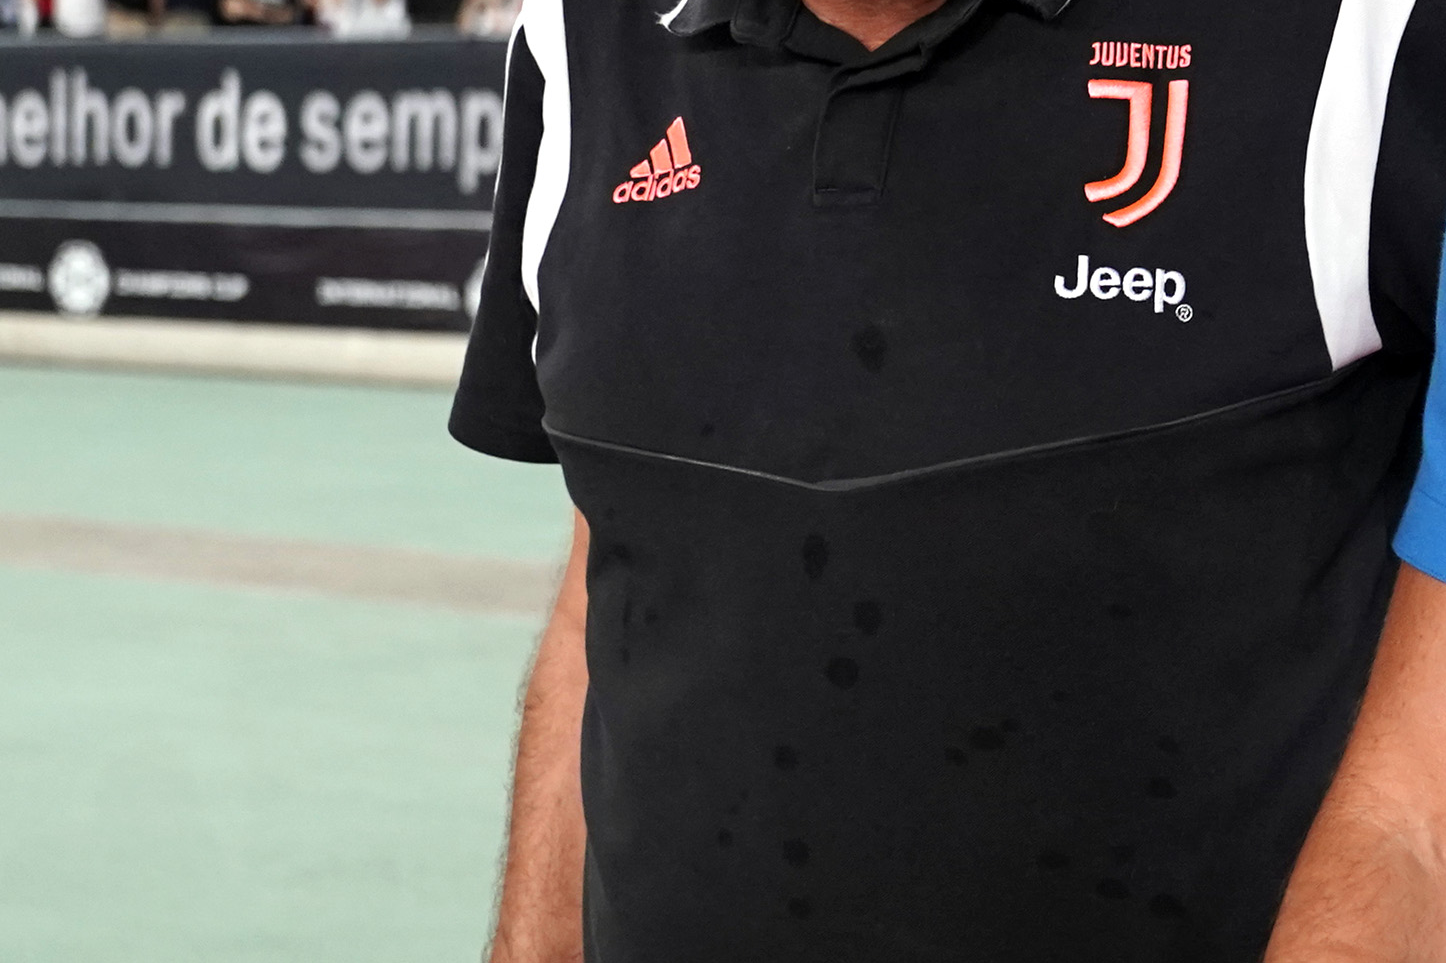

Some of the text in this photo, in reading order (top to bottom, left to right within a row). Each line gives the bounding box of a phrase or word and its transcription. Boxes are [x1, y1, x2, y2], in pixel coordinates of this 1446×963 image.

[1088, 41, 1193, 70] JUVENTUS
[0, 66, 187, 170] elhor
[195, 66, 288, 175] de
[612, 162, 702, 204] adidas
[1054, 254, 1187, 314] Jeep
